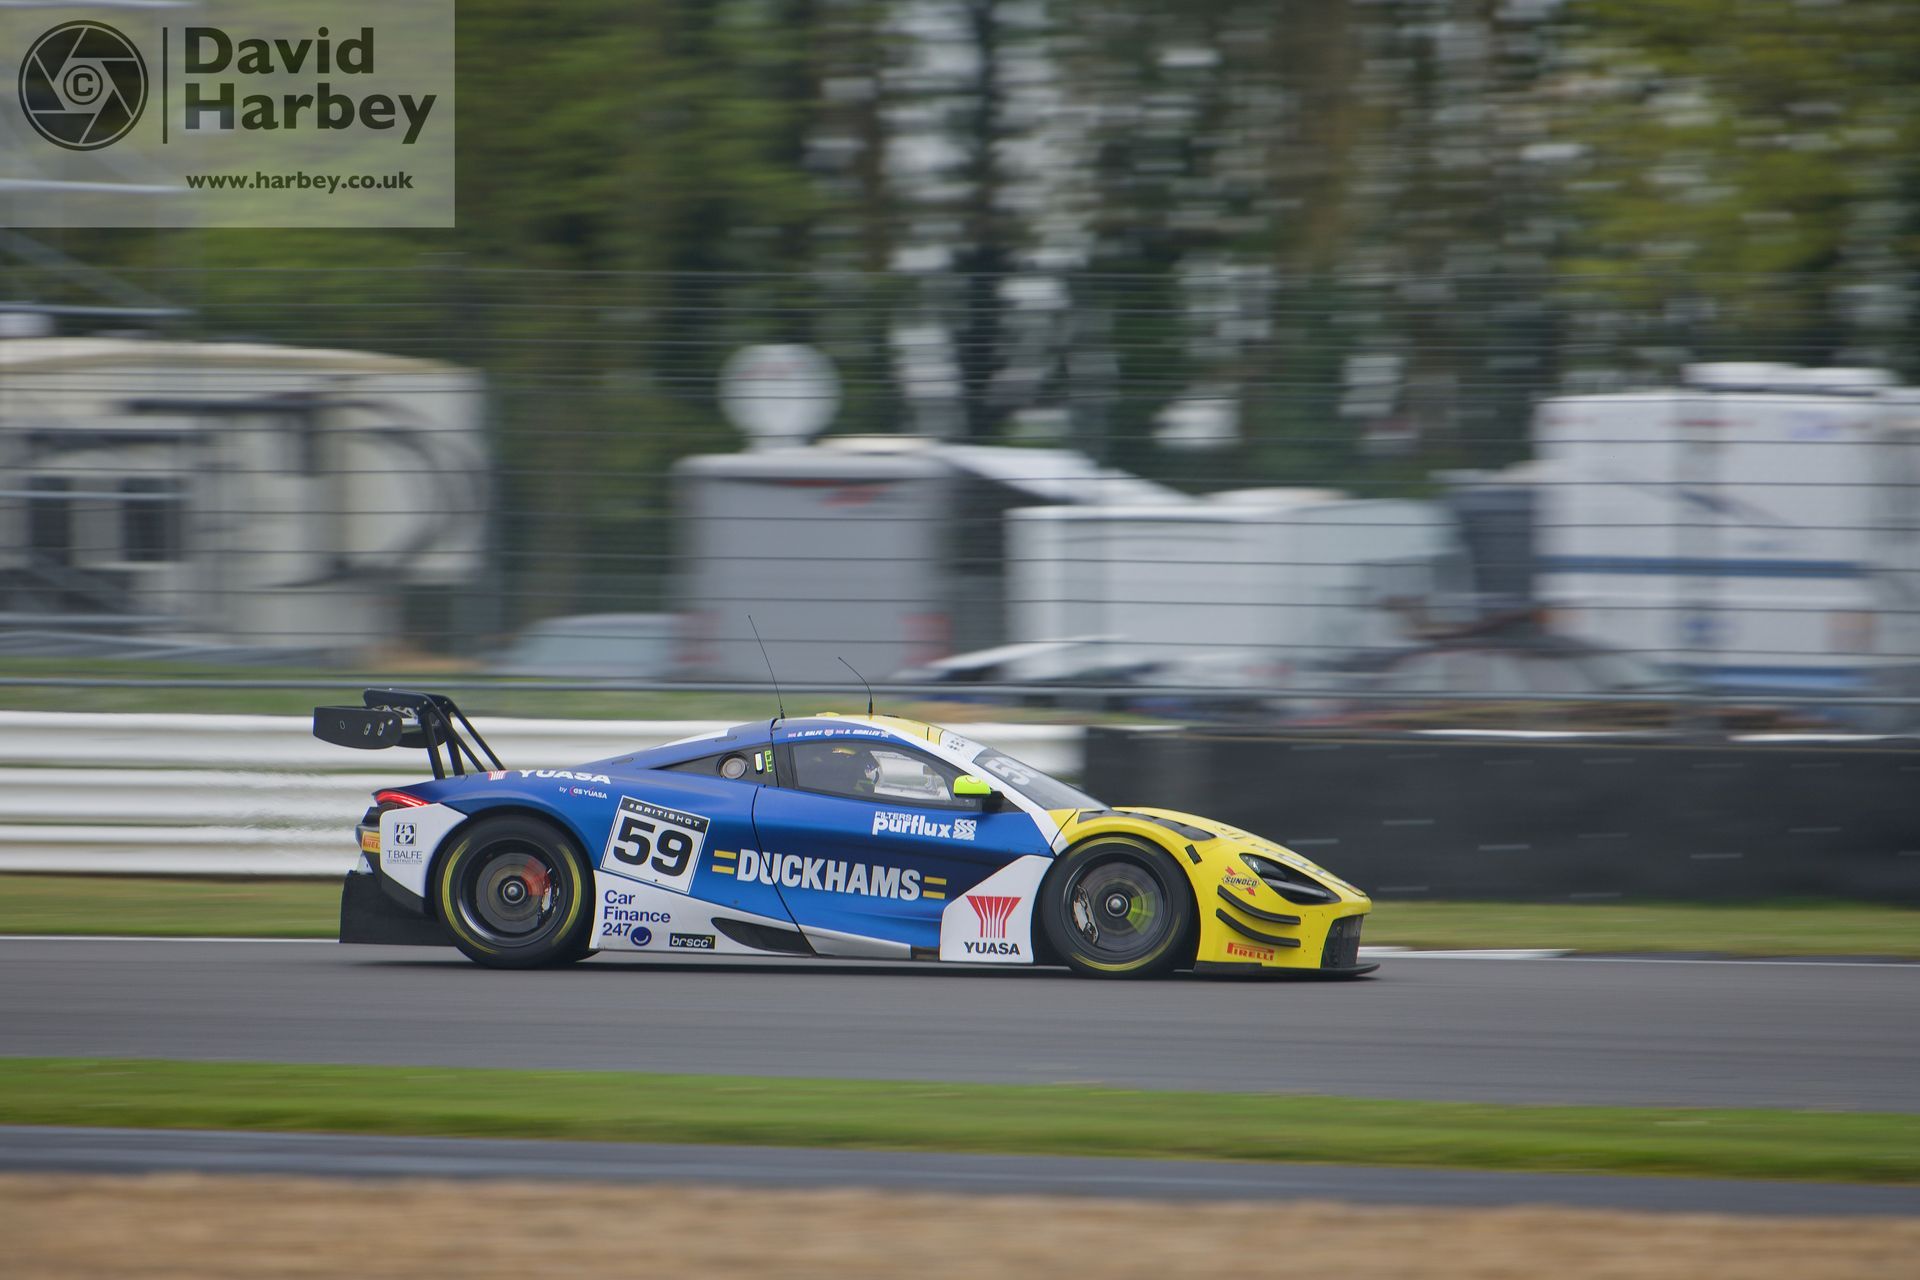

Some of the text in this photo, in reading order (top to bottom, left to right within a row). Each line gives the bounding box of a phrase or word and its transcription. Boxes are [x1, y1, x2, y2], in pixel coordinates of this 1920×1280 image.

[519, 770, 611, 784] YUASA
[583, 789, 608, 799] YUASA
[629, 803, 700, 827] #BRITISHGT
[875, 811, 912, 821] FILTERS
[872, 814, 951, 838] purflux
[613, 816, 693, 877] 59
[737, 849, 920, 900] DUCKHAMS
[1224, 876, 1258, 887] SUNOCO
[604, 890, 636, 905] Car
[604, 906, 671, 923] Finance
[602, 922, 632, 936] 247
[671, 935, 709, 948] brscc
[964, 941, 1020, 955] YUASA
[1227, 943, 1274, 961] PIRELLI
